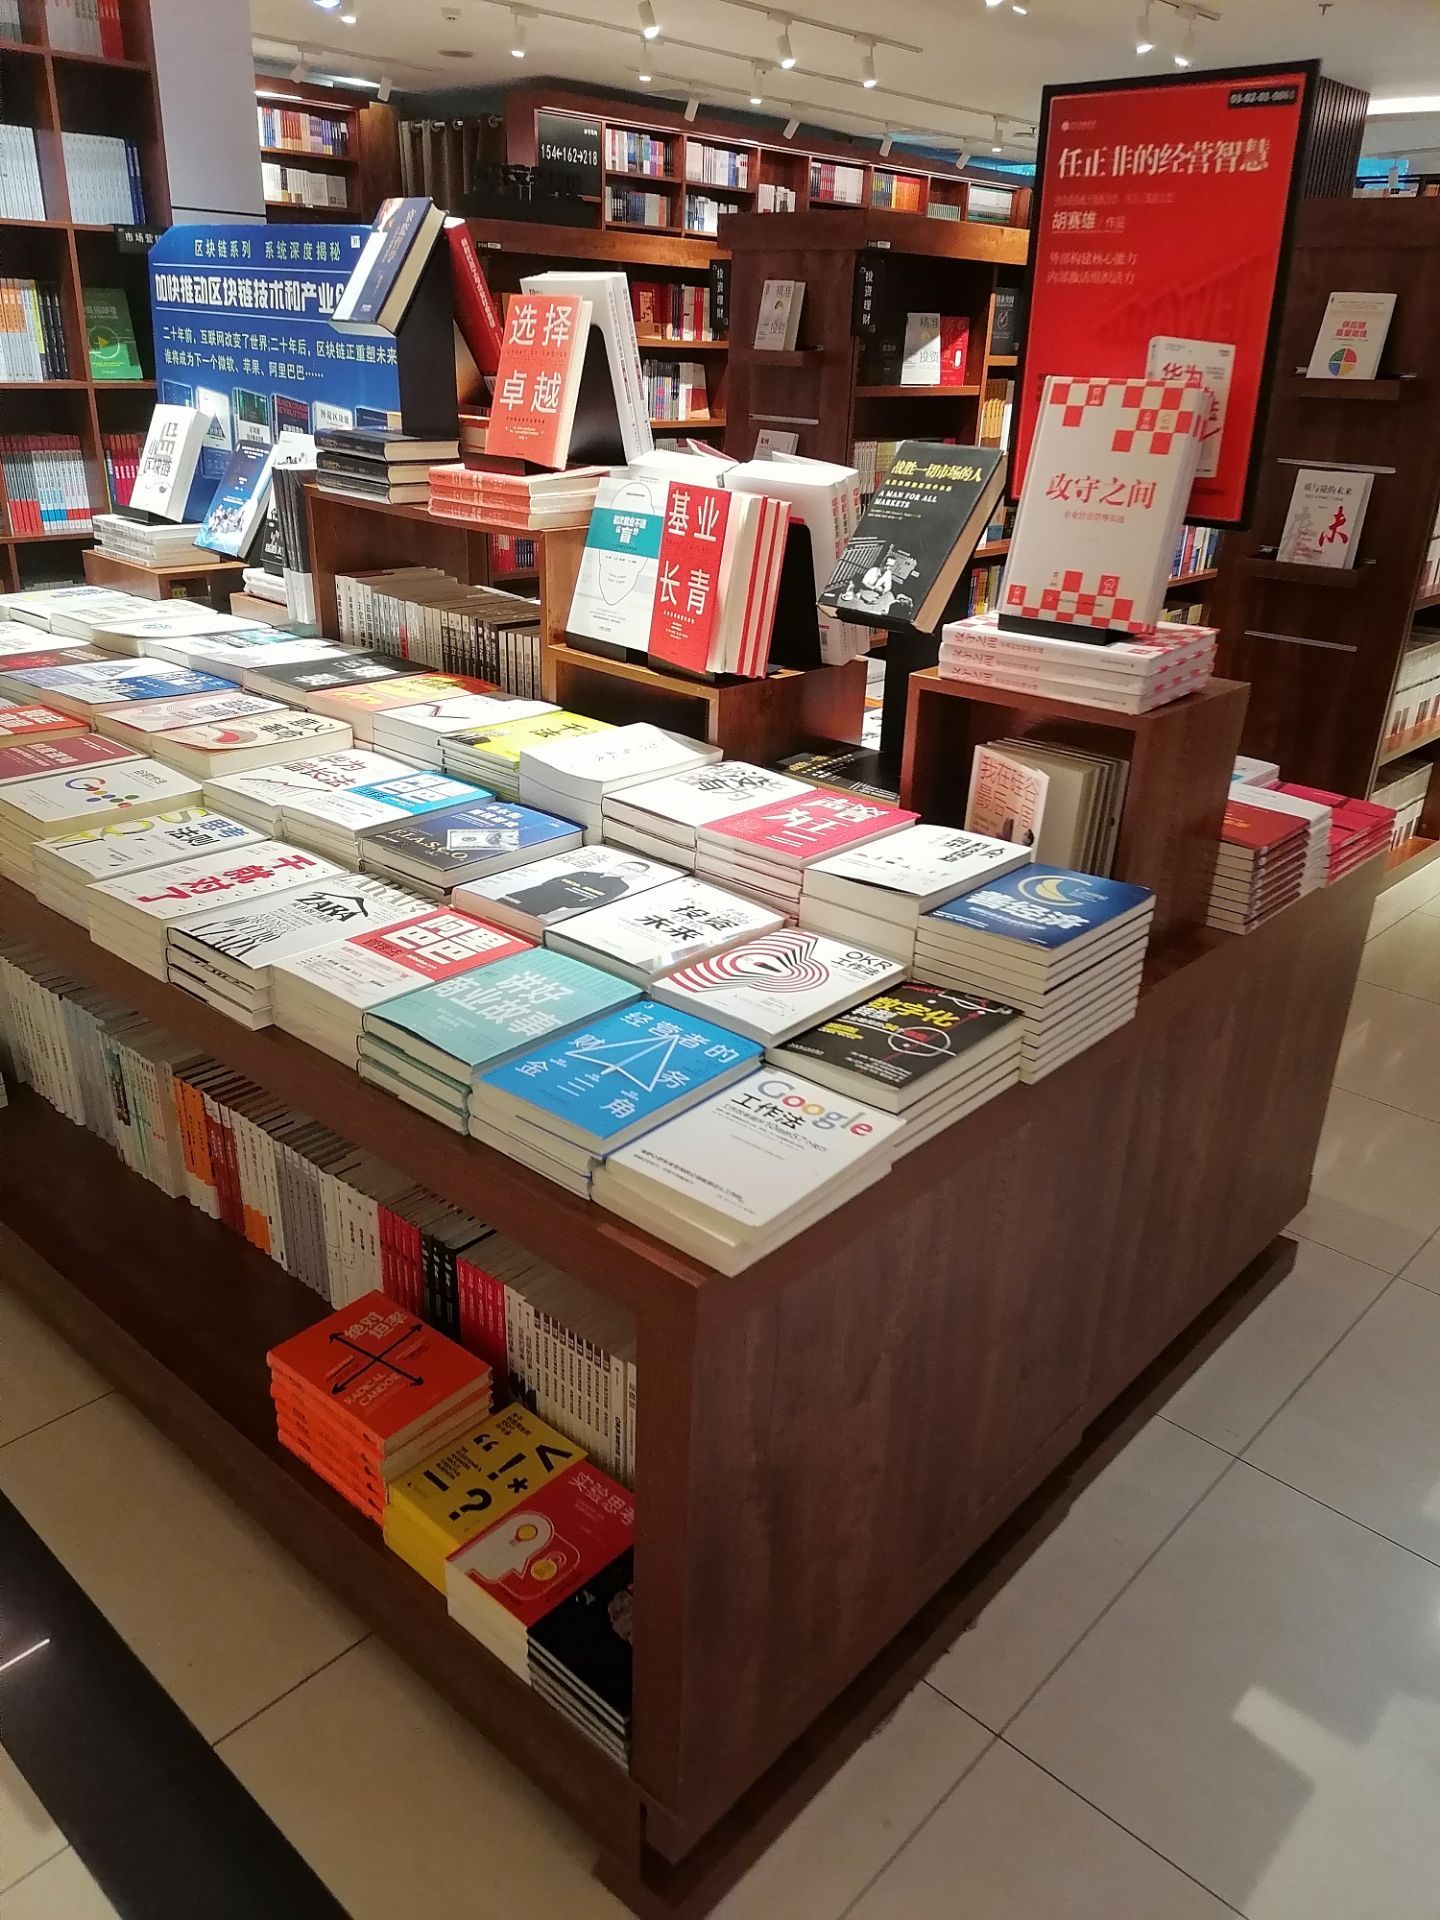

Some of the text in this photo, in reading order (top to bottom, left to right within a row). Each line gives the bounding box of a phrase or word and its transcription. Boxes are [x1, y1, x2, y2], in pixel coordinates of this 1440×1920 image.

[541, 144, 598, 166] 154 162 218
[1058, 138, 1271, 179] 任正非的经营智慧
[1052, 211, 1097, 231] 胡赛雄
[194, 239, 341, 261] 区块链系列 系统深度揭秘
[715, 268, 725, 319] 投资理财
[861, 270, 874, 326] 投资理财
[509, 304, 573, 348] 选择
[500, 369, 562, 414] 卓越
[891, 460, 983, 482] 战胜一切市场的人
[873, 498, 910, 509] MARKETS
[885, 490, 903, 499] MAN
[904, 492, 920, 501] FOR
[921, 494, 938, 503] ALL
[1046, 472, 1157, 510] 攻守之间
[667, 489, 721, 542] 基业
[659, 560, 711, 616] 长青
[164, 827, 221, 847] 法则
[200, 818, 250, 839] 思考
[137, 854, 317, 904] 干就对了
[296, 893, 359, 922] ZARA
[670, 904, 740, 931] 投资
[634, 913, 704, 941] 未来
[845, 951, 893, 971] OKR
[424, 975, 564, 1037] 商业故事
[495, 969, 576, 1008] 讲好
[868, 995, 961, 1028] 数字化
[620, 1010, 740, 1064] 经营者的
[731, 1092, 805, 1130] 工作法
[757, 1080, 873, 1136] Google
[343, 1371, 387, 1405] RADICAL
[567, 1470, 636, 1528] 实验思考
